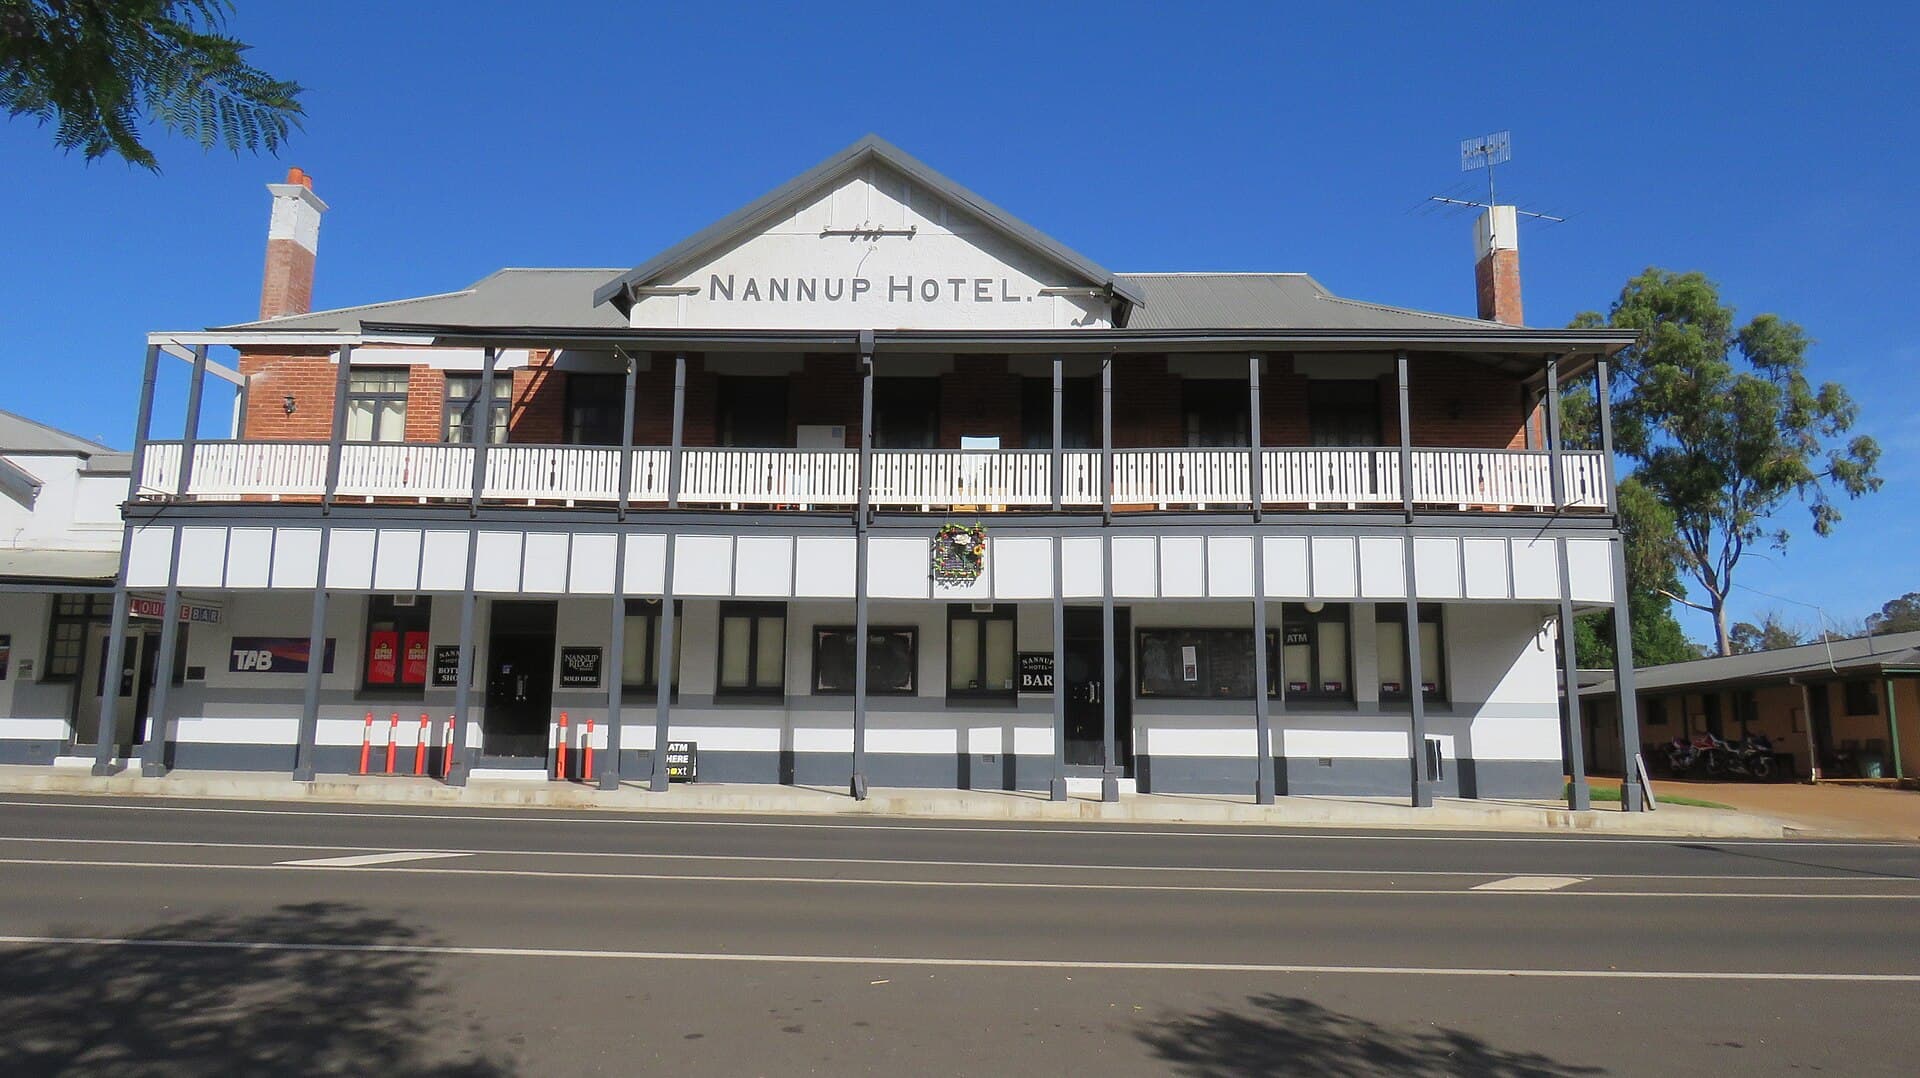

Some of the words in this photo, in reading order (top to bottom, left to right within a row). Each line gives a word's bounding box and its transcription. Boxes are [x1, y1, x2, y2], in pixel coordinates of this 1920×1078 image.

[709, 274, 870, 302] NANNUP
[888, 275, 1033, 302] HOTEL.
[131, 600, 189, 619] LOUE
[193, 608, 217, 621] BAR
[1287, 633, 1308, 643] ATM
[440, 650, 460, 659] NANN
[565, 654, 599, 662] NANNUP
[233, 650, 273, 670] TAB
[569, 660, 593, 669] RIDGE
[1023, 674, 1053, 686] BAR
[668, 743, 688, 752] ATM
[666, 754, 689, 763] HERE
